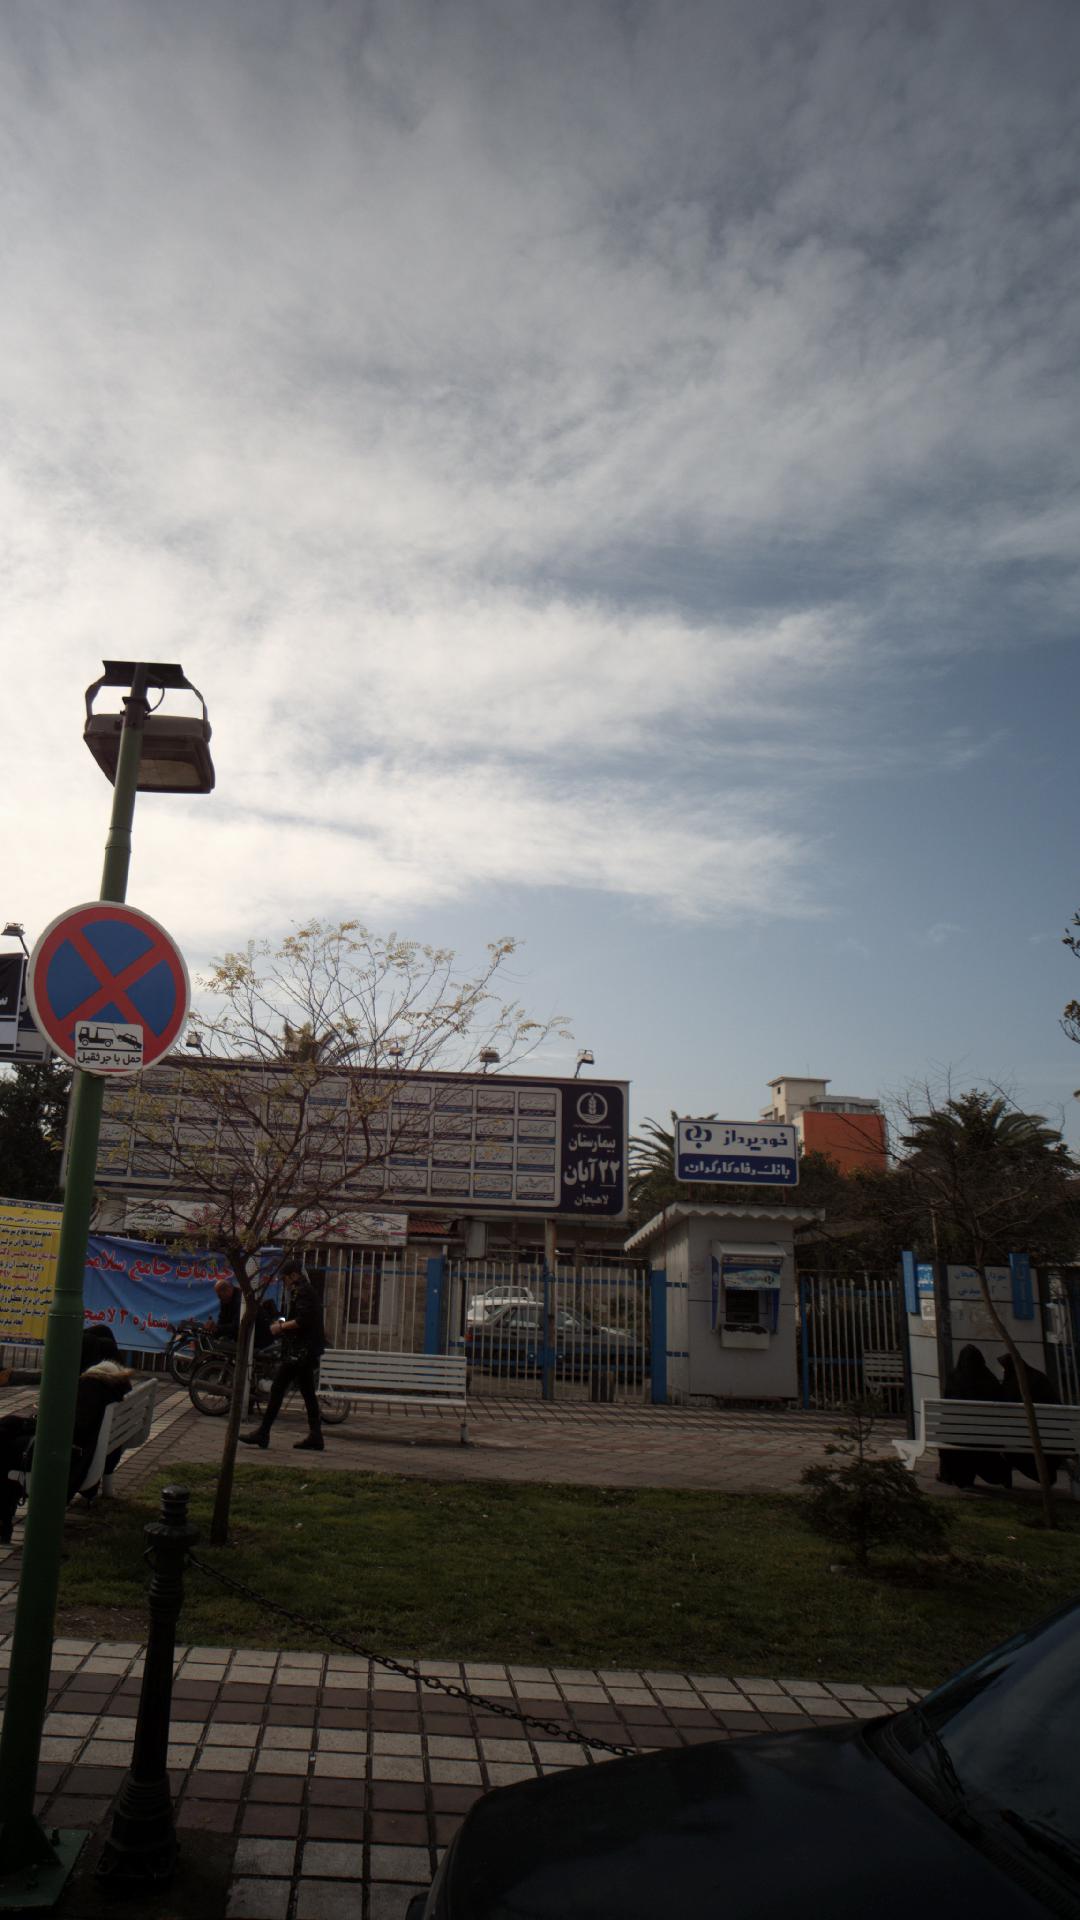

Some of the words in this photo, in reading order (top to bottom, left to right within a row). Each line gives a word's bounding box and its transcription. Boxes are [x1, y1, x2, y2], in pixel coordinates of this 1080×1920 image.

[113, 1053, 121, 1065] با
[122, 1054, 142, 1066] حمل
[568, 1132, 617, 1153] بیمارستان
[723, 1129, 788, 1151] خودپرداز
[563, 1157, 599, 1189] آبان
[599, 1158, 621, 1185] ۲۲
[733, 1162, 757, 1176] رفاه
[574, 1193, 609, 1207] لاهیجان
[84, 1249, 127, 1273] سلام
[129, 1256, 171, 1283] جامع
